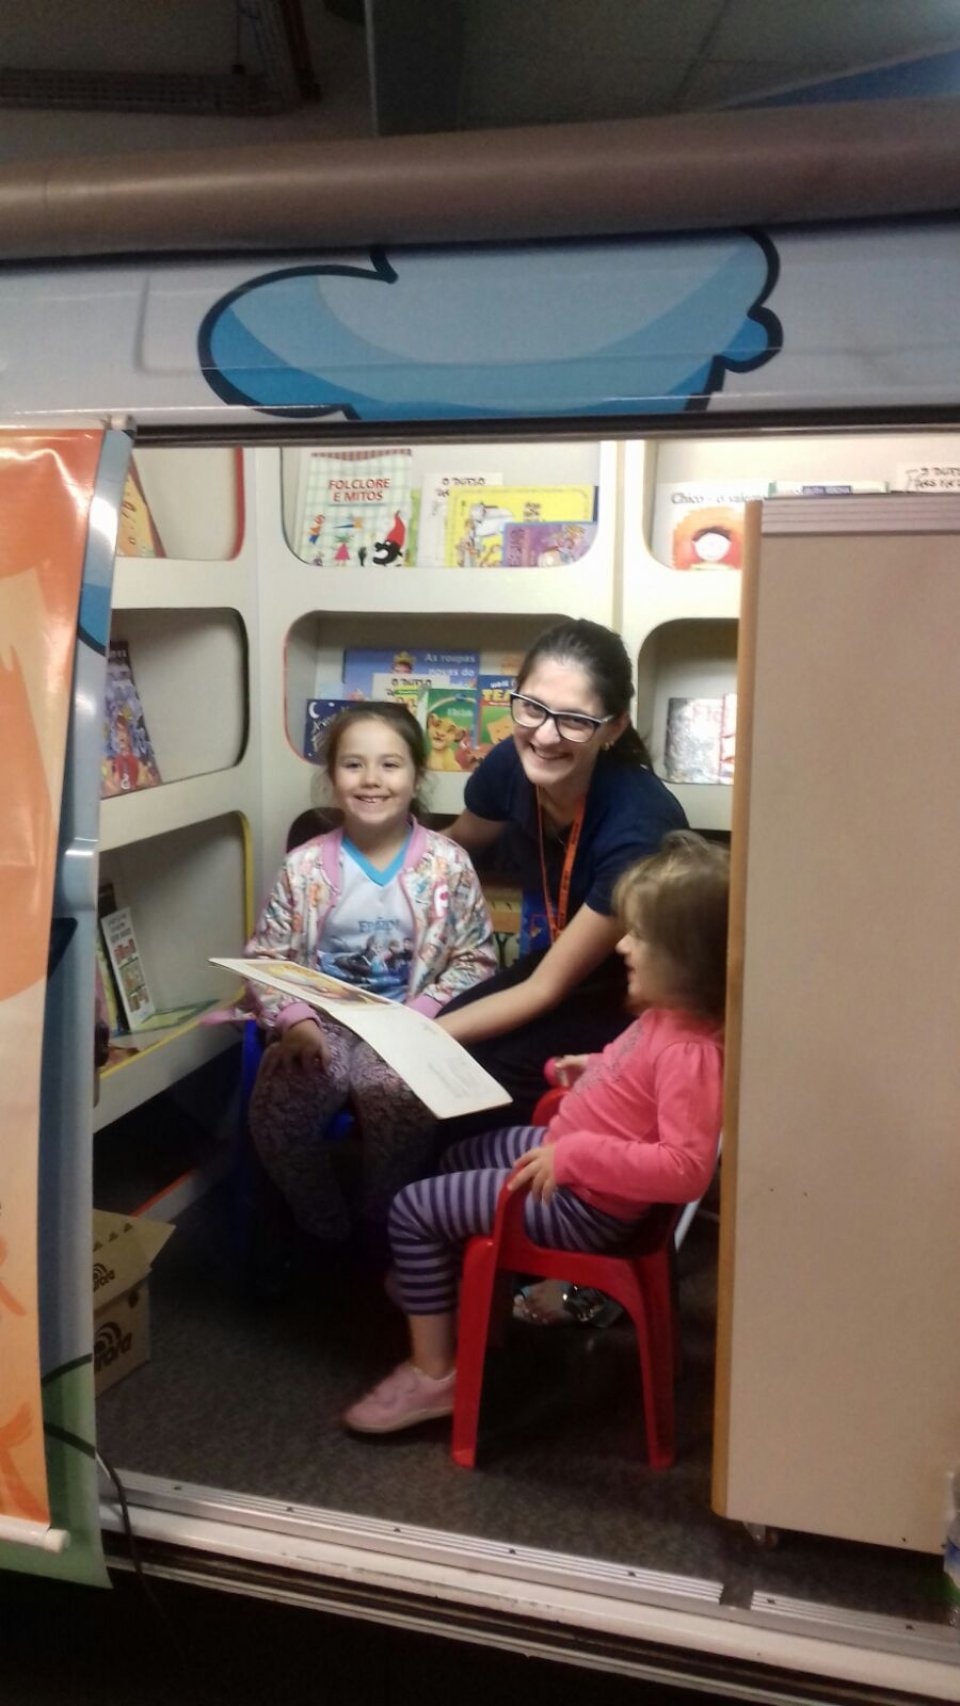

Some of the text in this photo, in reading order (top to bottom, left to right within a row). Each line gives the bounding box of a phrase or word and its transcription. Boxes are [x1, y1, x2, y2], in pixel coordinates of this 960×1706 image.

[328, 478, 391, 490] FOLCLORE
[333, 491, 383, 502] E MITOS
[425, 652, 476, 665] As roupas
[461, 667, 476, 677] do
